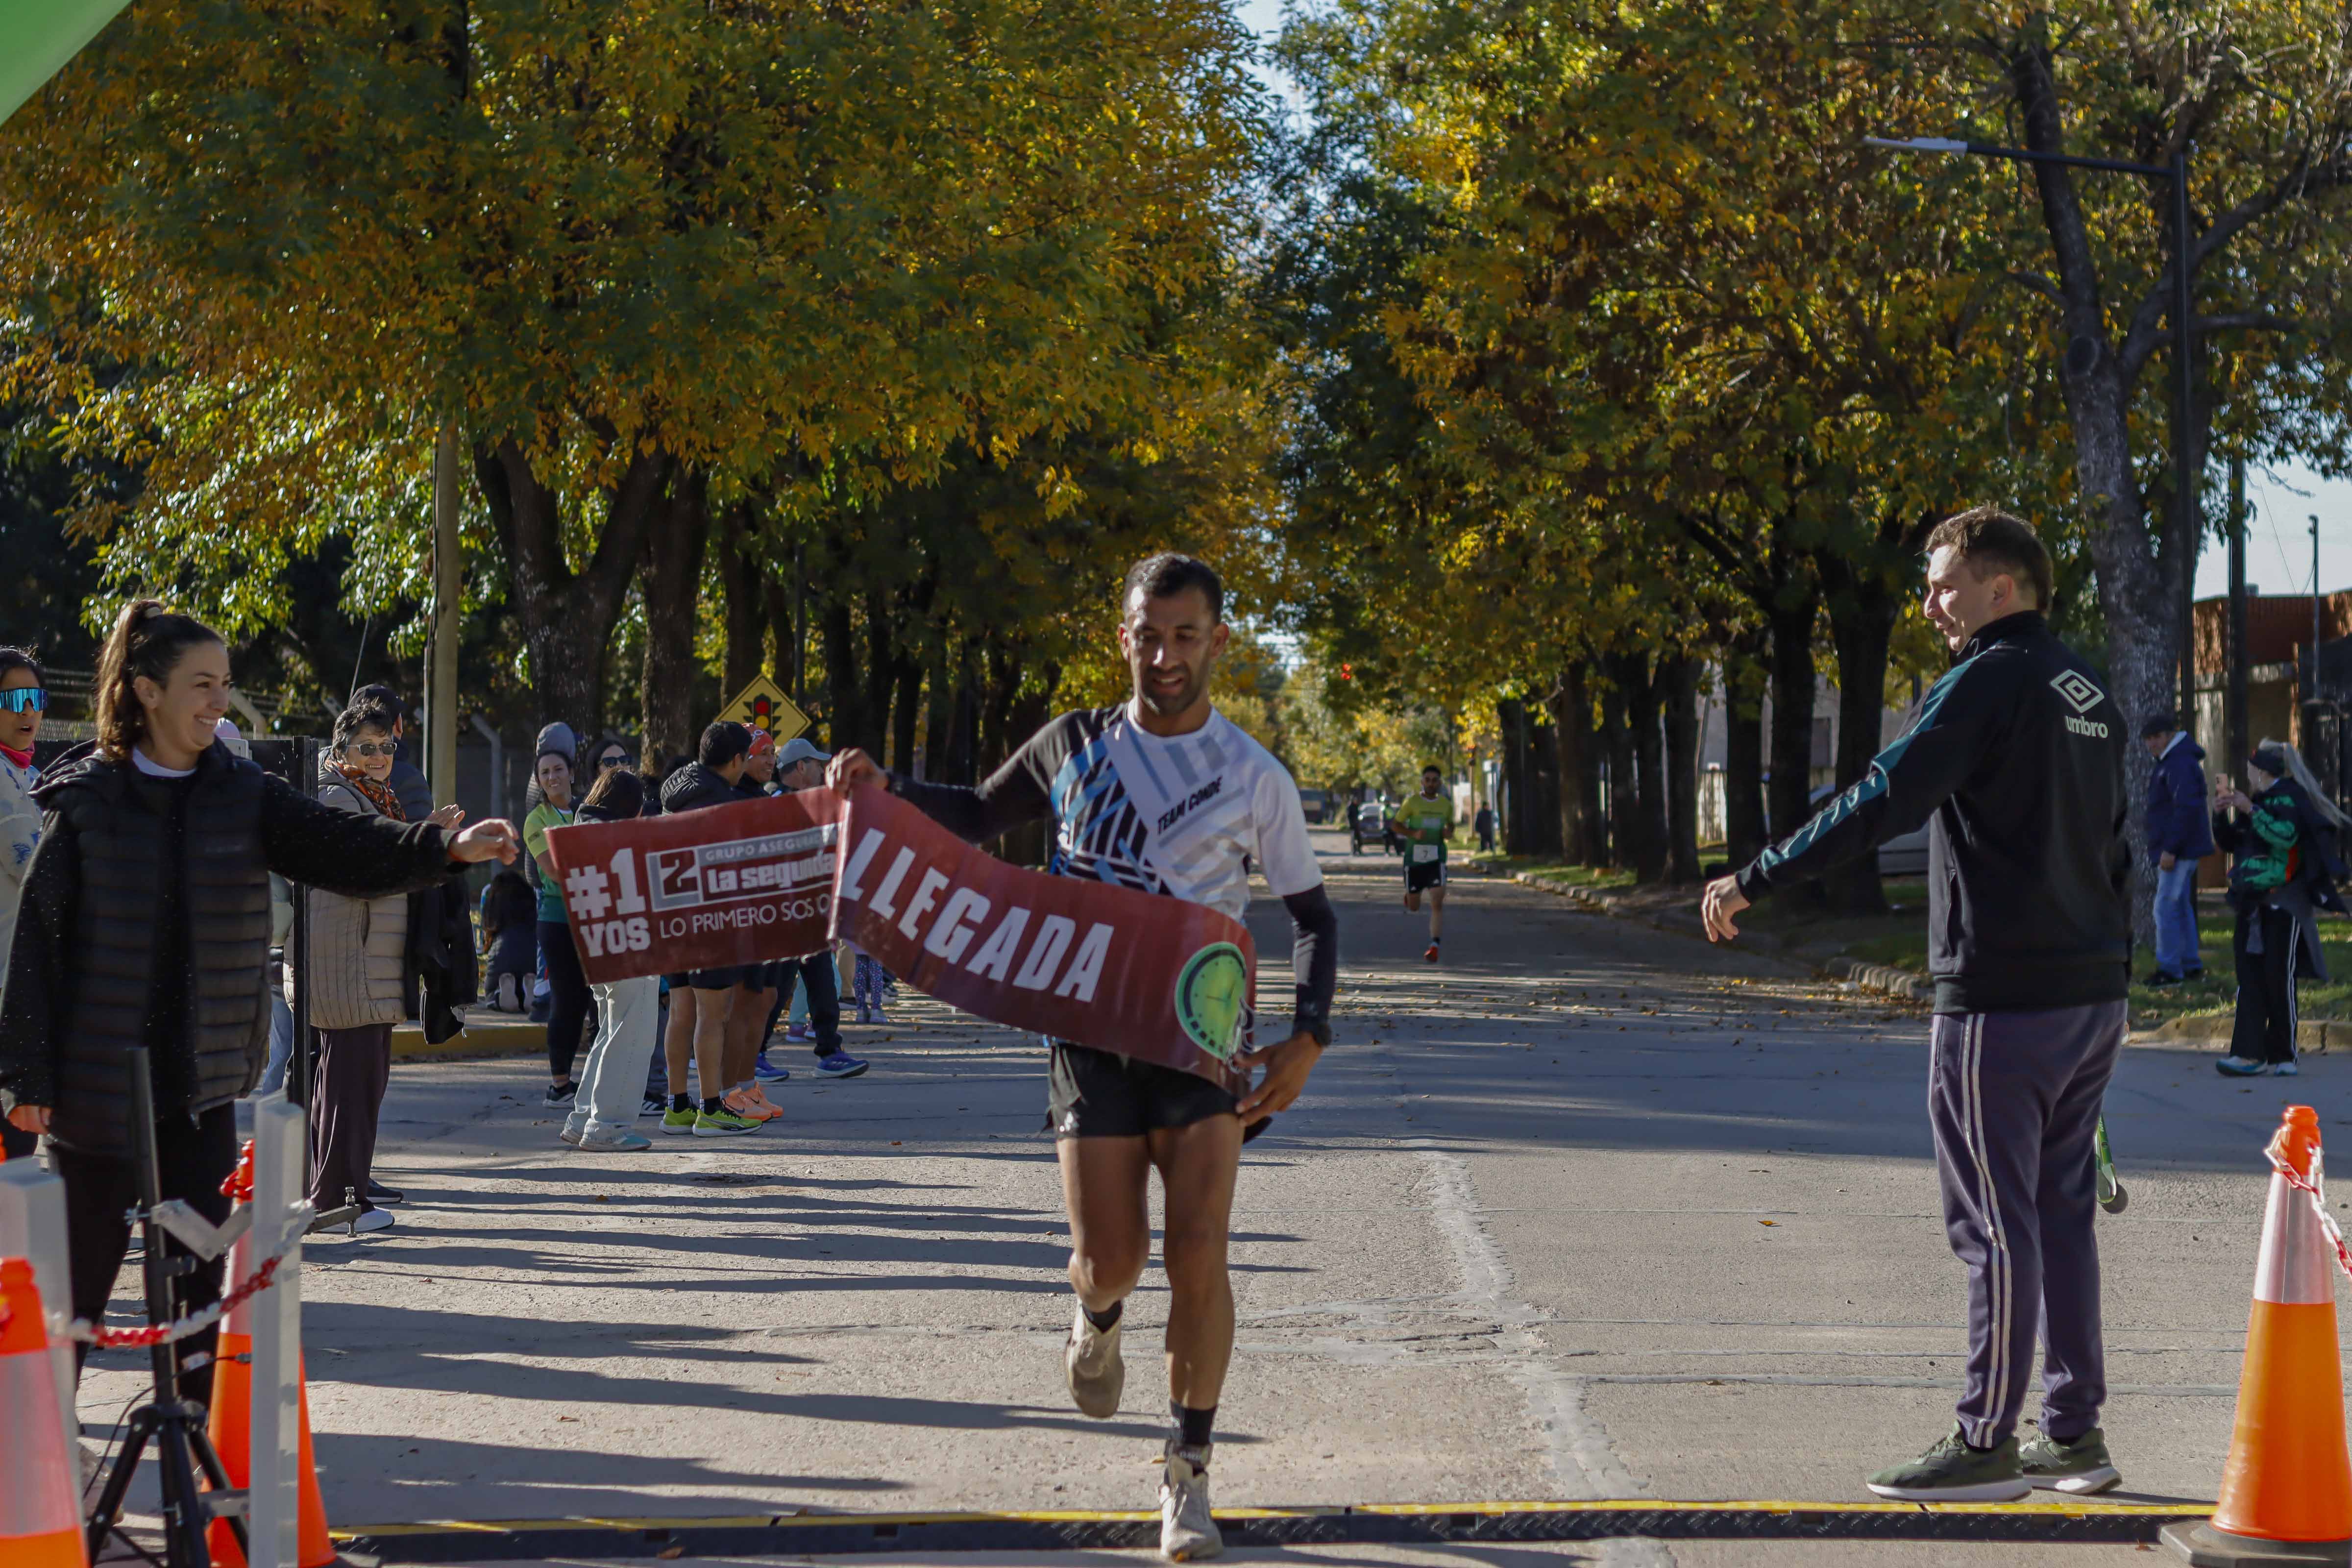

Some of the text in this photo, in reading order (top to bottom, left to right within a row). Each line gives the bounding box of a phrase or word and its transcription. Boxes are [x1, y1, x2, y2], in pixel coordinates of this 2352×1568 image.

[2065, 715, 2108, 738] umbro
[1157, 798, 1186, 835] TEAM
[705, 845, 755, 861] GRUPO
[565, 848, 646, 920] #1
[707, 868, 738, 894] la
[660, 917, 686, 938] LO
[692, 904, 777, 933] PRIMERO
[781, 898, 814, 921] SOS
[839, 828, 1114, 1003] LLEGADA
